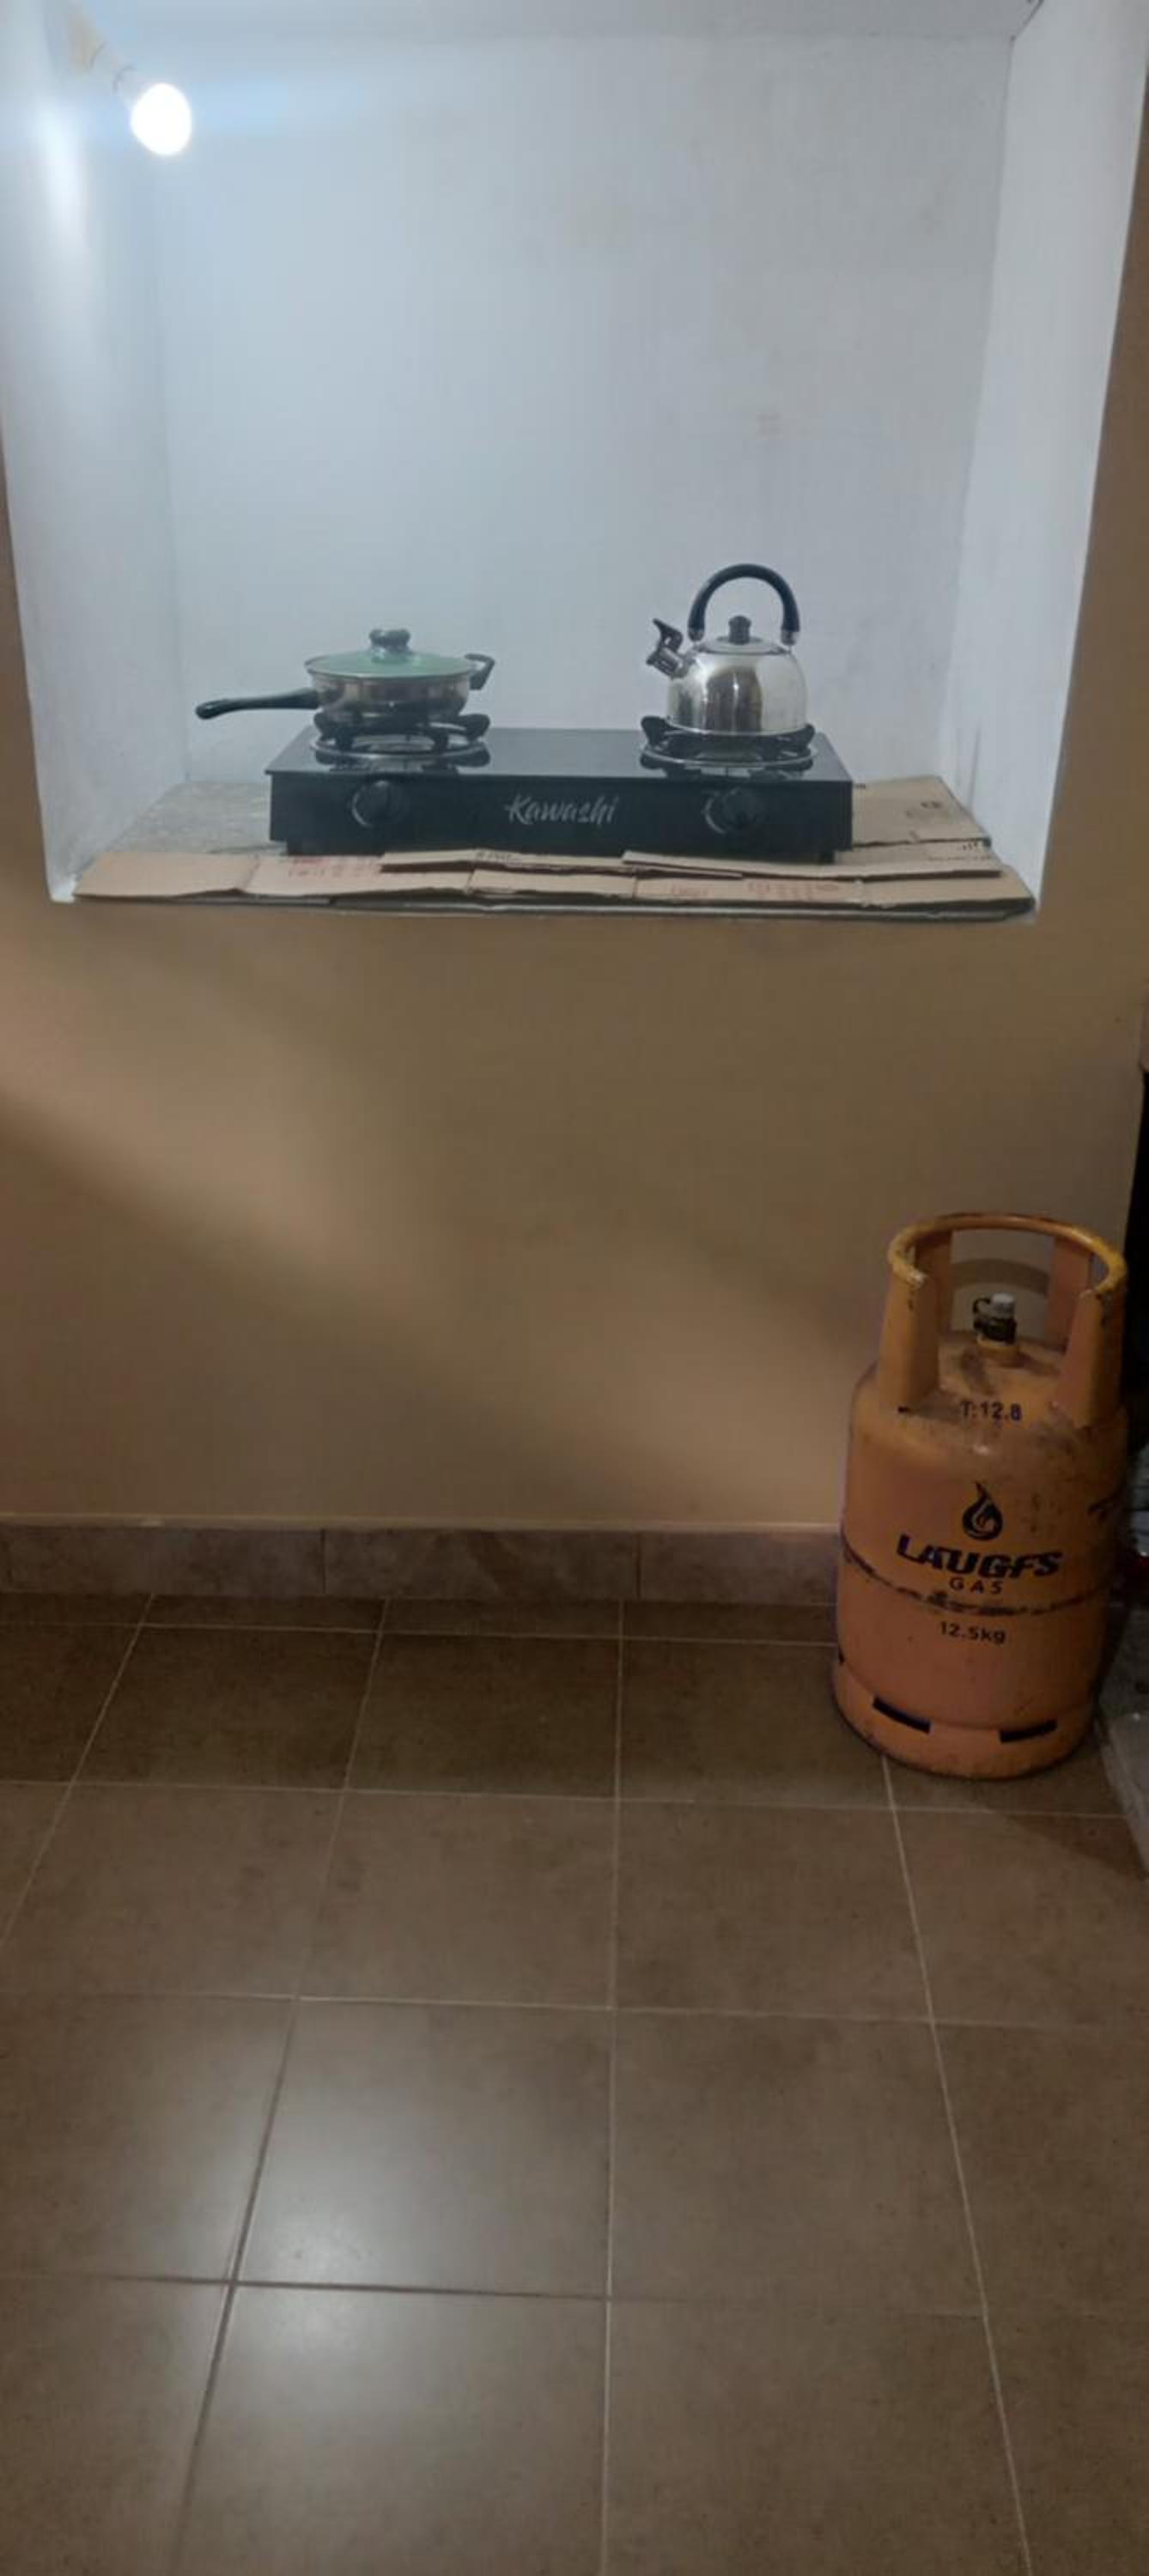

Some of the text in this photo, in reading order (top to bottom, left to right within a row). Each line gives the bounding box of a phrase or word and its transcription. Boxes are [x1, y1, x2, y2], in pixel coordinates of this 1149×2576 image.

[505, 793, 619, 825] Kawashi
[897, 1534, 1063, 1579] LAUGFS
[949, 1577, 1004, 1595] GAS
[939, 1620, 1006, 1645] 12.5kg
